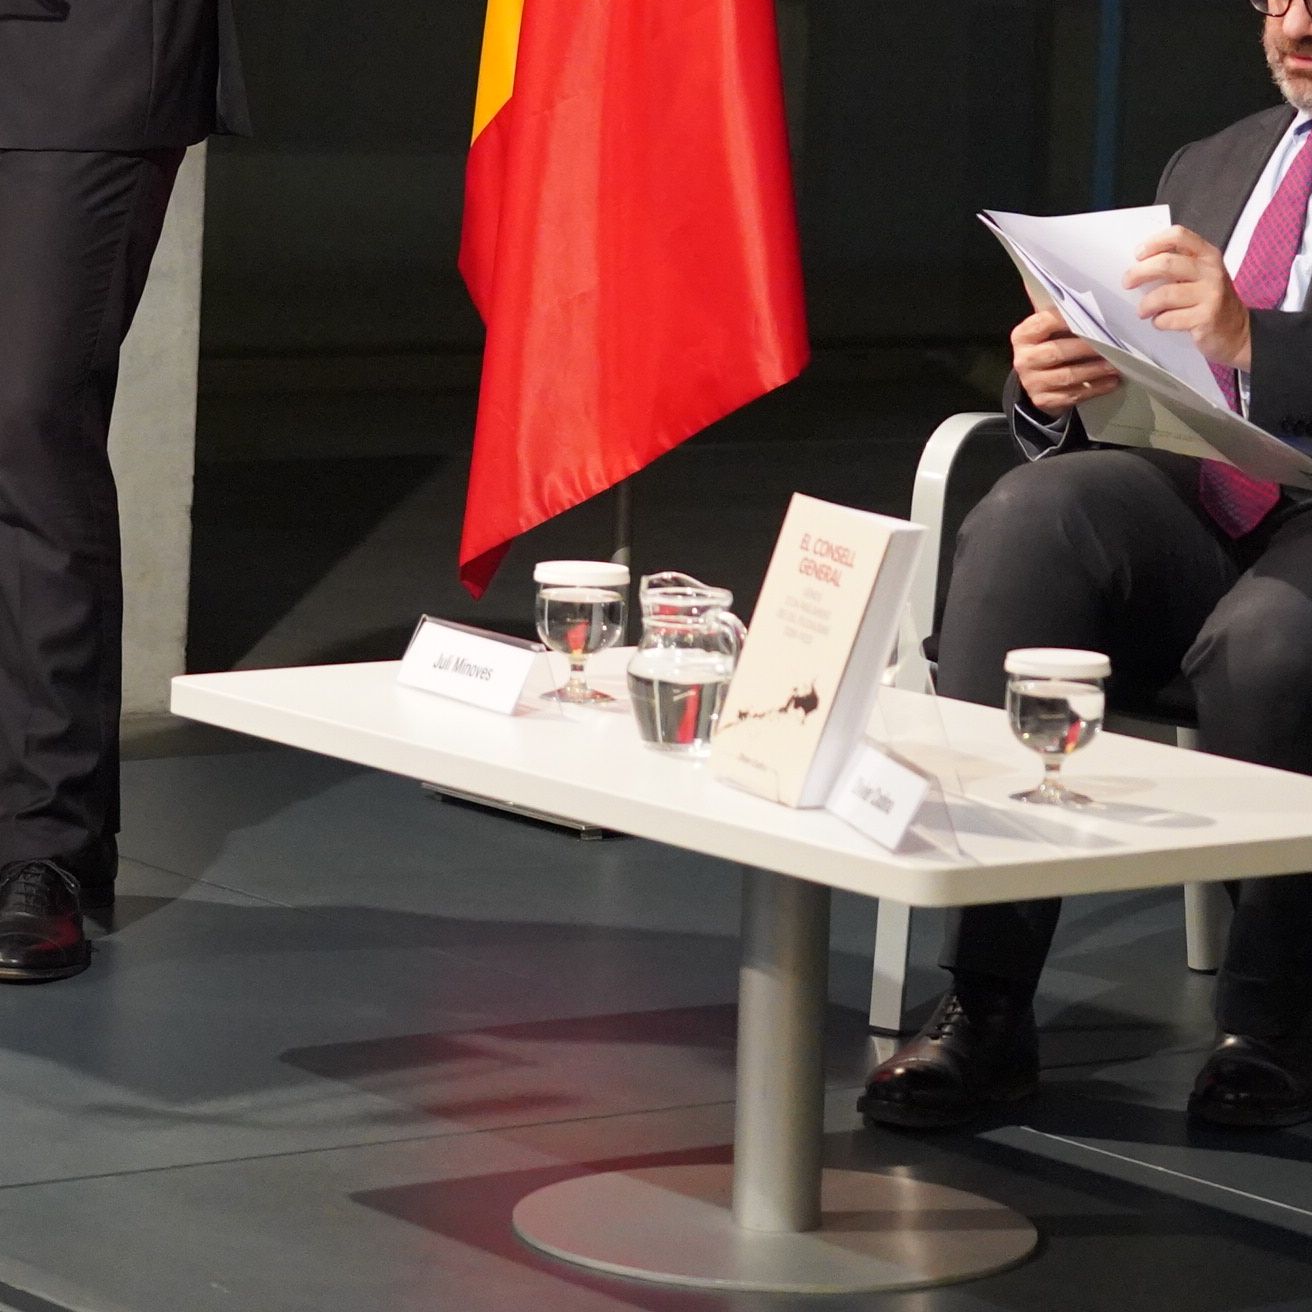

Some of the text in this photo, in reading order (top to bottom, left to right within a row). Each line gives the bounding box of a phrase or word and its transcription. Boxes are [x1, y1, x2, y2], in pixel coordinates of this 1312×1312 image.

[799, 533, 855, 568] EL CONSELL
[799, 558, 841, 588] GENERAL
[453, 657, 494, 681] Minoves
